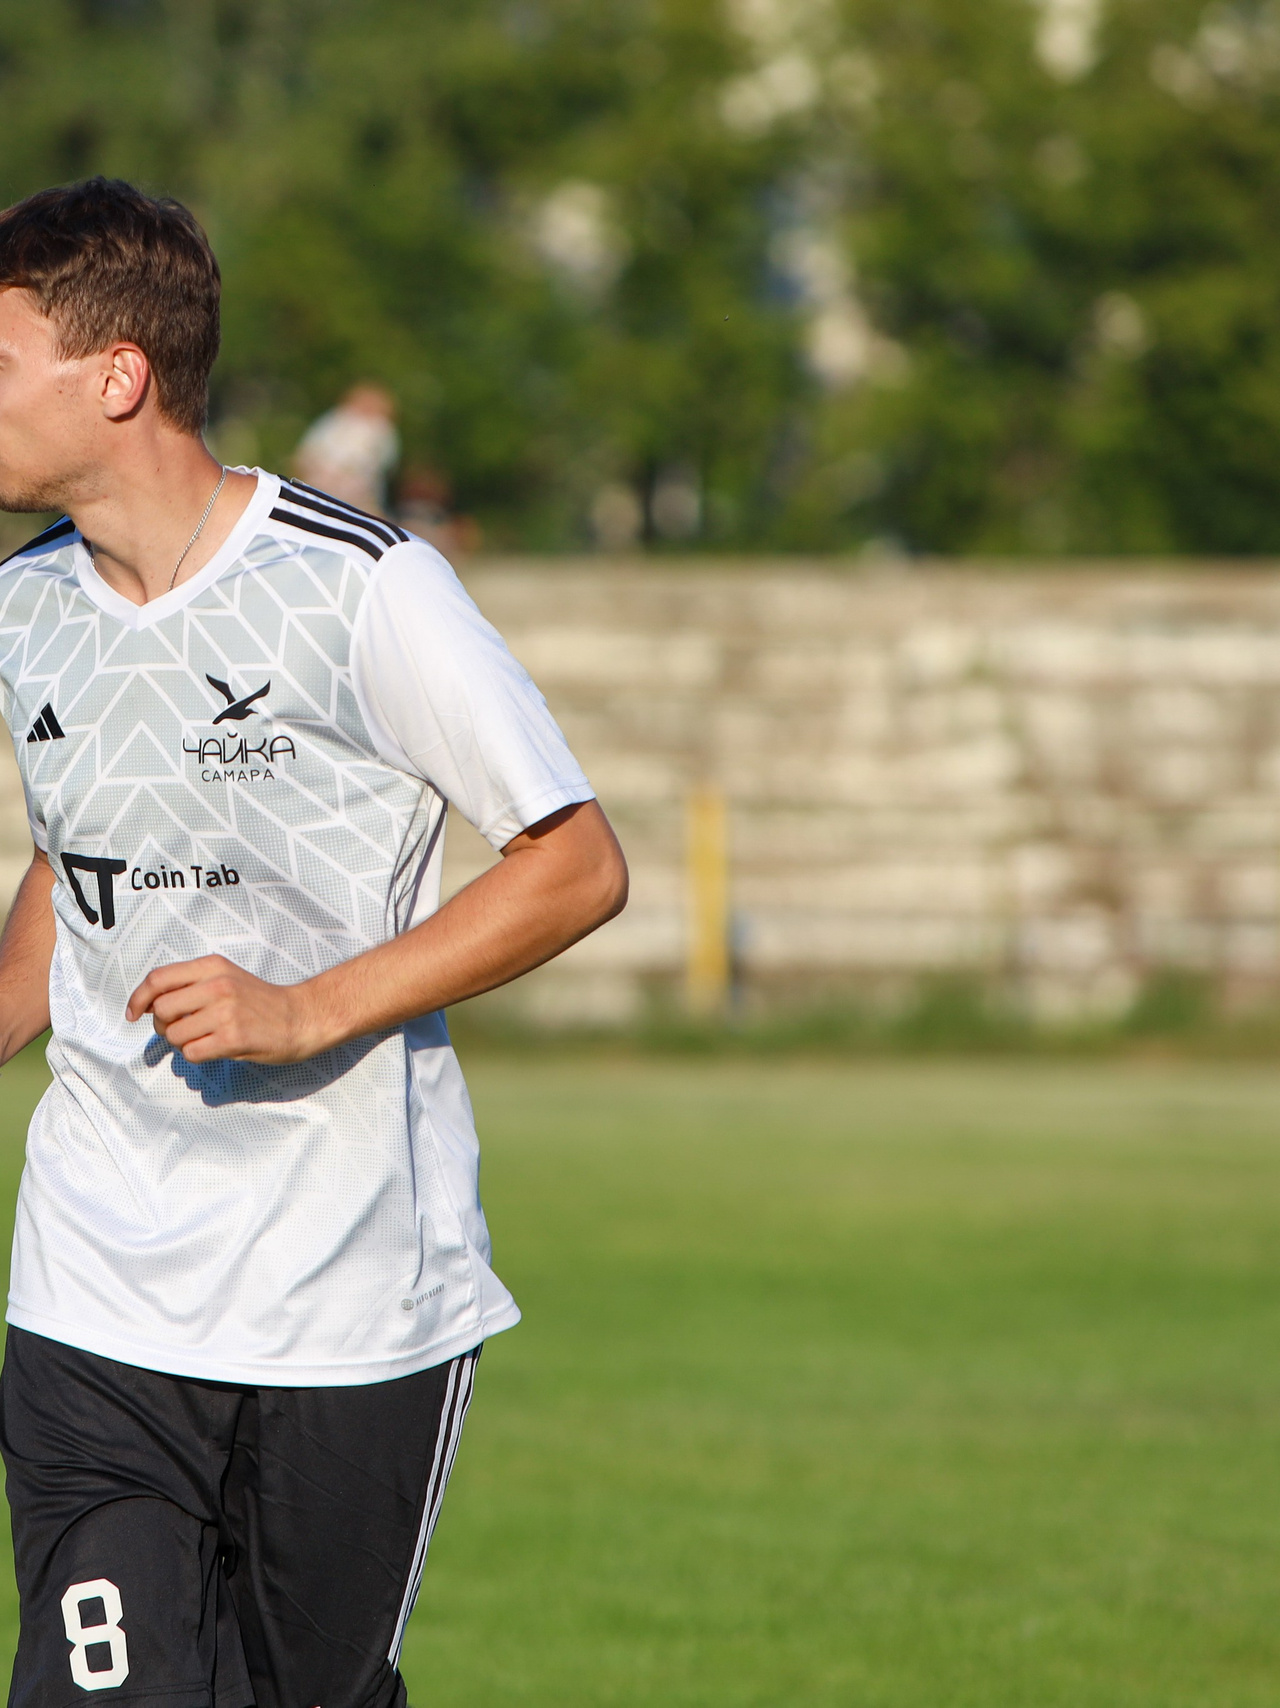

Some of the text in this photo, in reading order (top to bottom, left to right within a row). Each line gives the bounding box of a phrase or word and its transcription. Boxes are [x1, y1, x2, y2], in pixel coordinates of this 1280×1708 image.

[182, 732, 296, 764] ЧАЙКА
[201, 768, 275, 782] САМАРА
[131, 864, 240, 891] Coin Tab
[60, 1577, 130, 1692] 8
